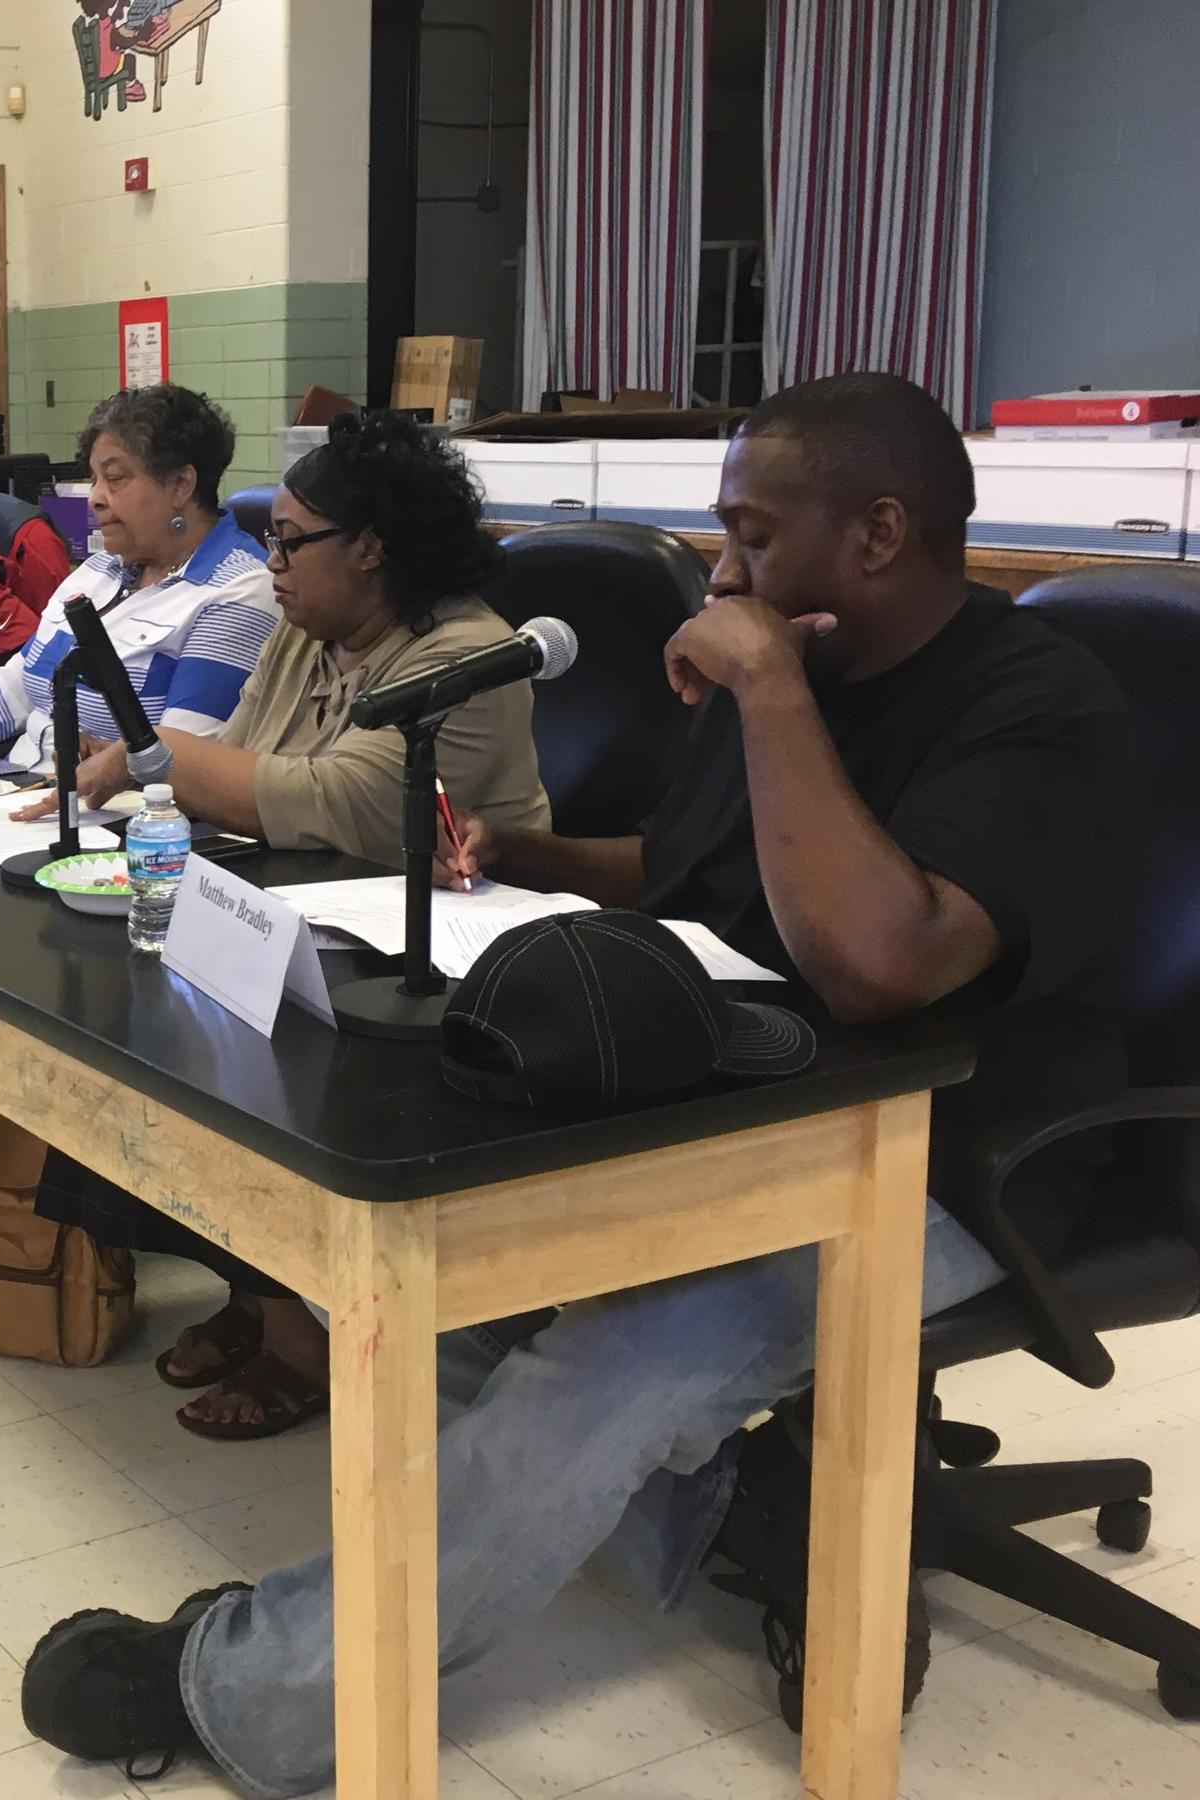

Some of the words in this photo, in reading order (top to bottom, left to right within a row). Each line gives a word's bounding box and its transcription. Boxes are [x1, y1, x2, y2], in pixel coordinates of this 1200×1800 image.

[145, 856, 157, 865] ICE
[198, 874, 237, 913] Matthew
[235, 897, 275, 942] Bradley
